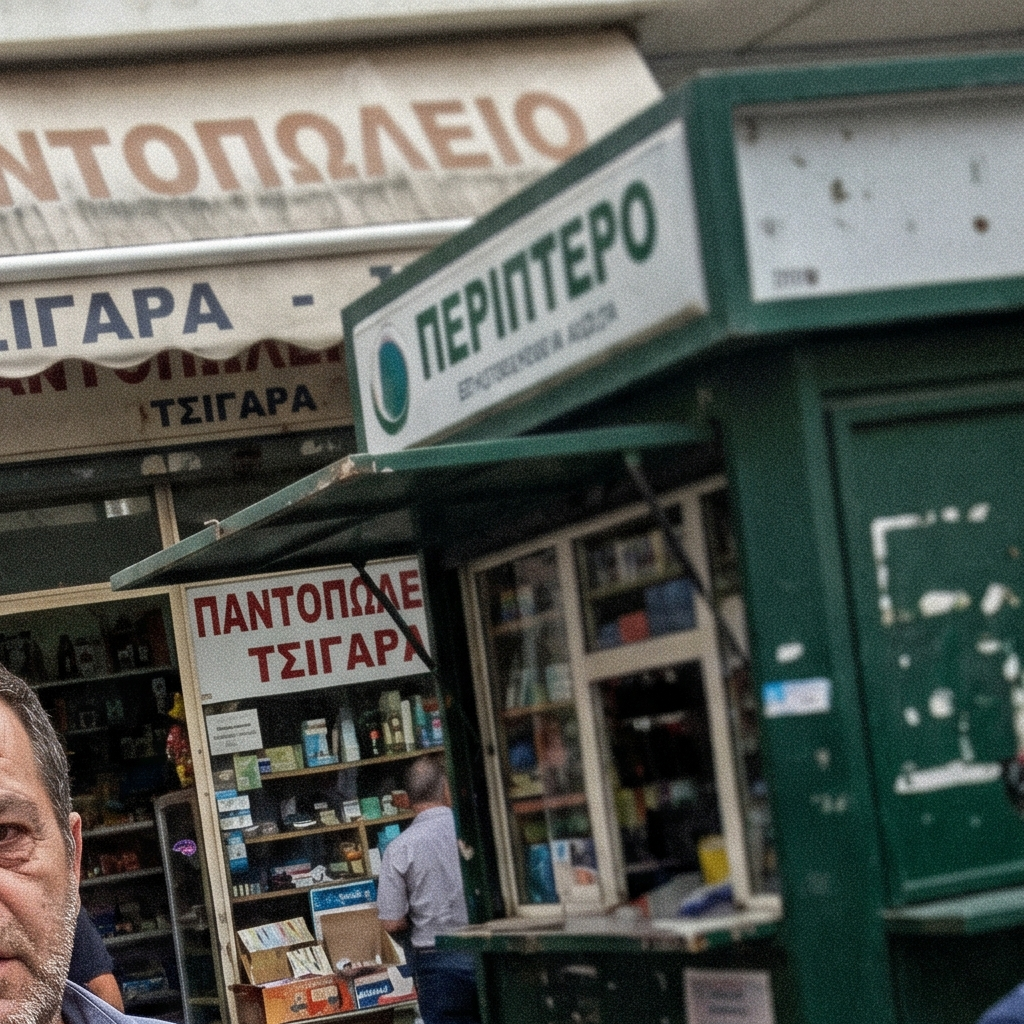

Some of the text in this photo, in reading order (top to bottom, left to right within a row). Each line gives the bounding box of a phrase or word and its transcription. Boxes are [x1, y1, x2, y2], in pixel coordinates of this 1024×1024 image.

[415, 179, 658, 380] ΠΕΡΙΠΤΕΡΟ
[150, 384, 318, 428] ΤΣΙΓΑΡΑ
[193, 569, 423, 638] ΠΑΝΤΟΠΩΛΕ
